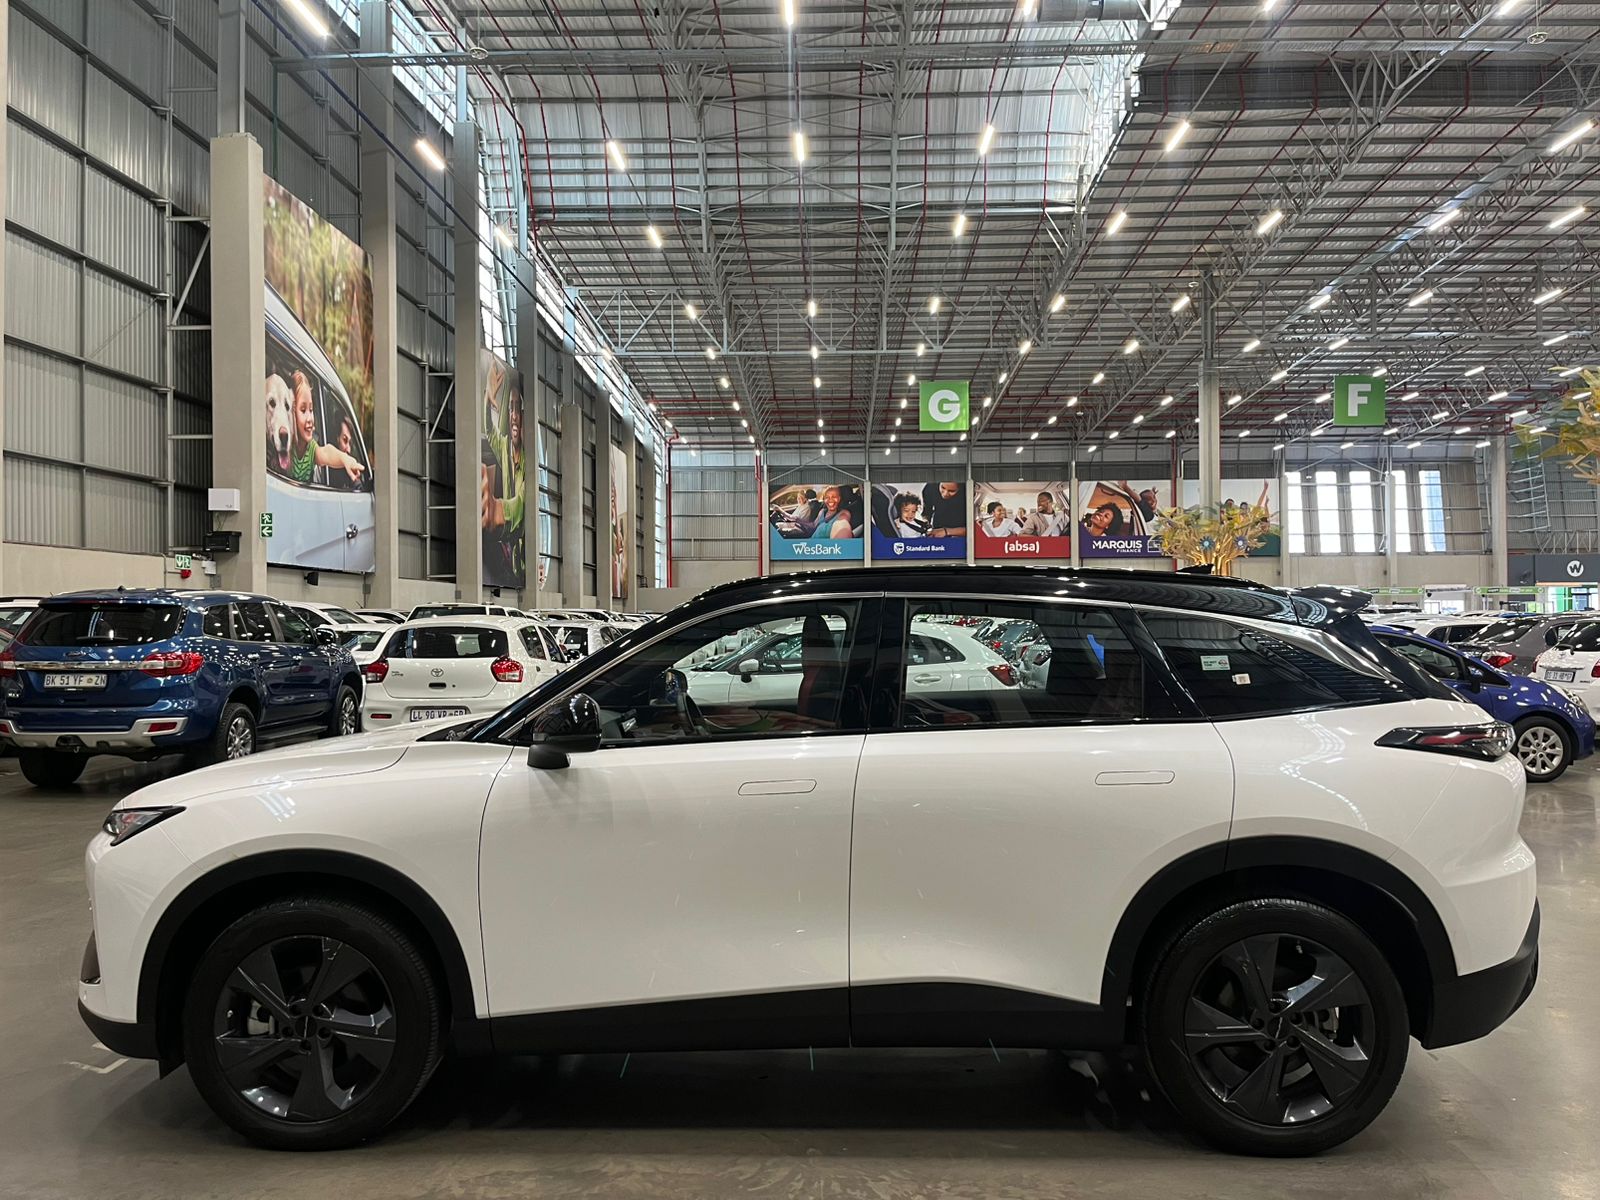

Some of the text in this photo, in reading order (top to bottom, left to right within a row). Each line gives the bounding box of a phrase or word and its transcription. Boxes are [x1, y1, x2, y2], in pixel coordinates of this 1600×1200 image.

[928, 389, 960, 423] G
[1348, 383, 1371, 417] F
[792, 542, 841, 555] WesBank
[1092, 540, 1142, 549] MARQUIS
[1568, 560, 1583, 575] W
[45, 675, 106, 686] BK 51 YF ZN
